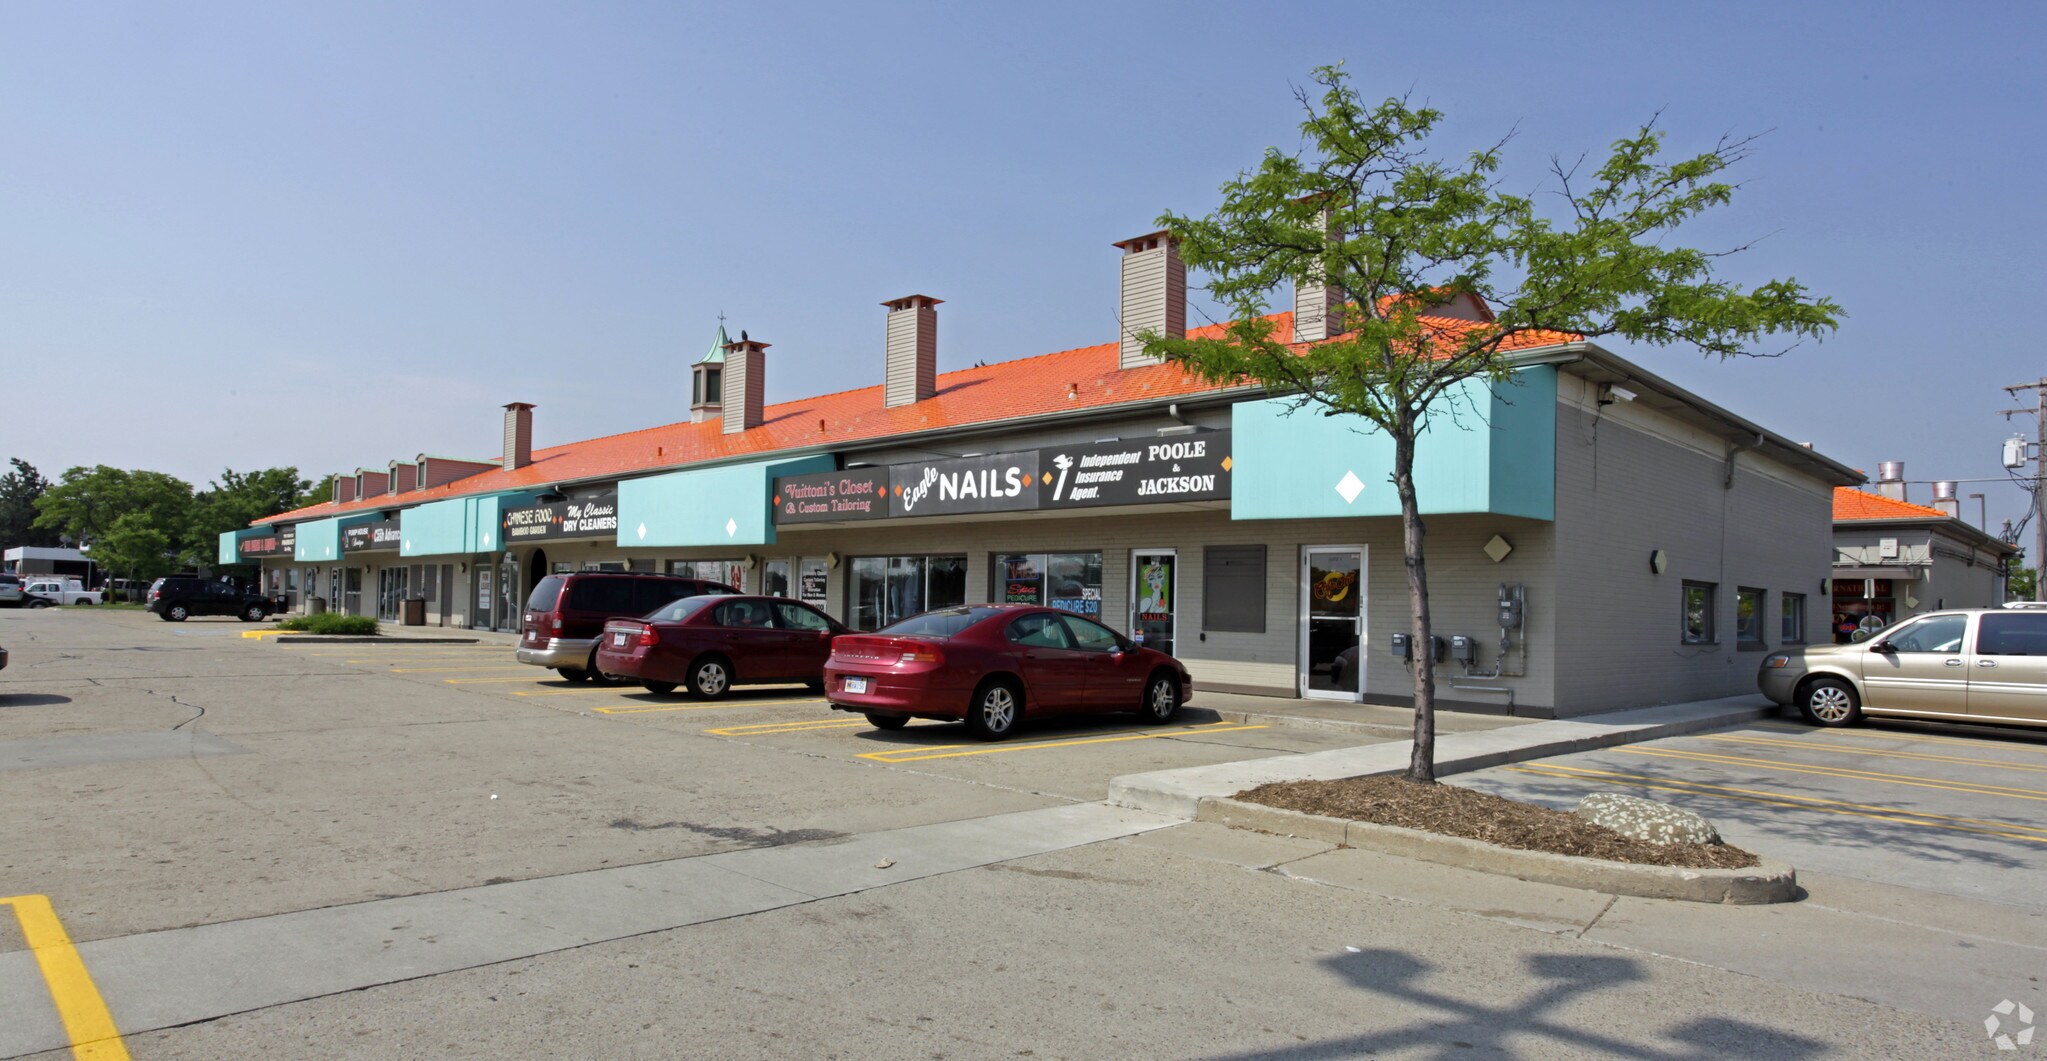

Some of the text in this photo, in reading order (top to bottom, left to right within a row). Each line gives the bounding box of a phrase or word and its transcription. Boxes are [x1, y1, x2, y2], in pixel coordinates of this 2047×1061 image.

[1148, 441, 1206, 461] POOLE
[1079, 451, 1142, 468] Independent
[1172, 463, 1181, 473] &
[940, 466, 1021, 501] NAILS
[1074, 469, 1124, 484] Insurance
[784, 479, 873, 499] Vuittoni's Closet
[903, 466, 938, 511] Eagle
[1137, 474, 1215, 496] JACKSON
[1069, 486, 1100, 501] Agent.
[567, 502, 614, 519] My Classic
[798, 501, 828, 514] Custom
[831, 498, 871, 513] Tailoring
[506, 507, 553, 526] CHINESE FOOD
[563, 516, 617, 532] DRY CLEANERS
[511, 525, 546, 537] BAMBOO GARDEN
[1082, 588, 1102, 600] SPECIAL
[1052, 600, 1098, 613] PEDICURE $20
[1142, 613, 1168, 621] NAILS
